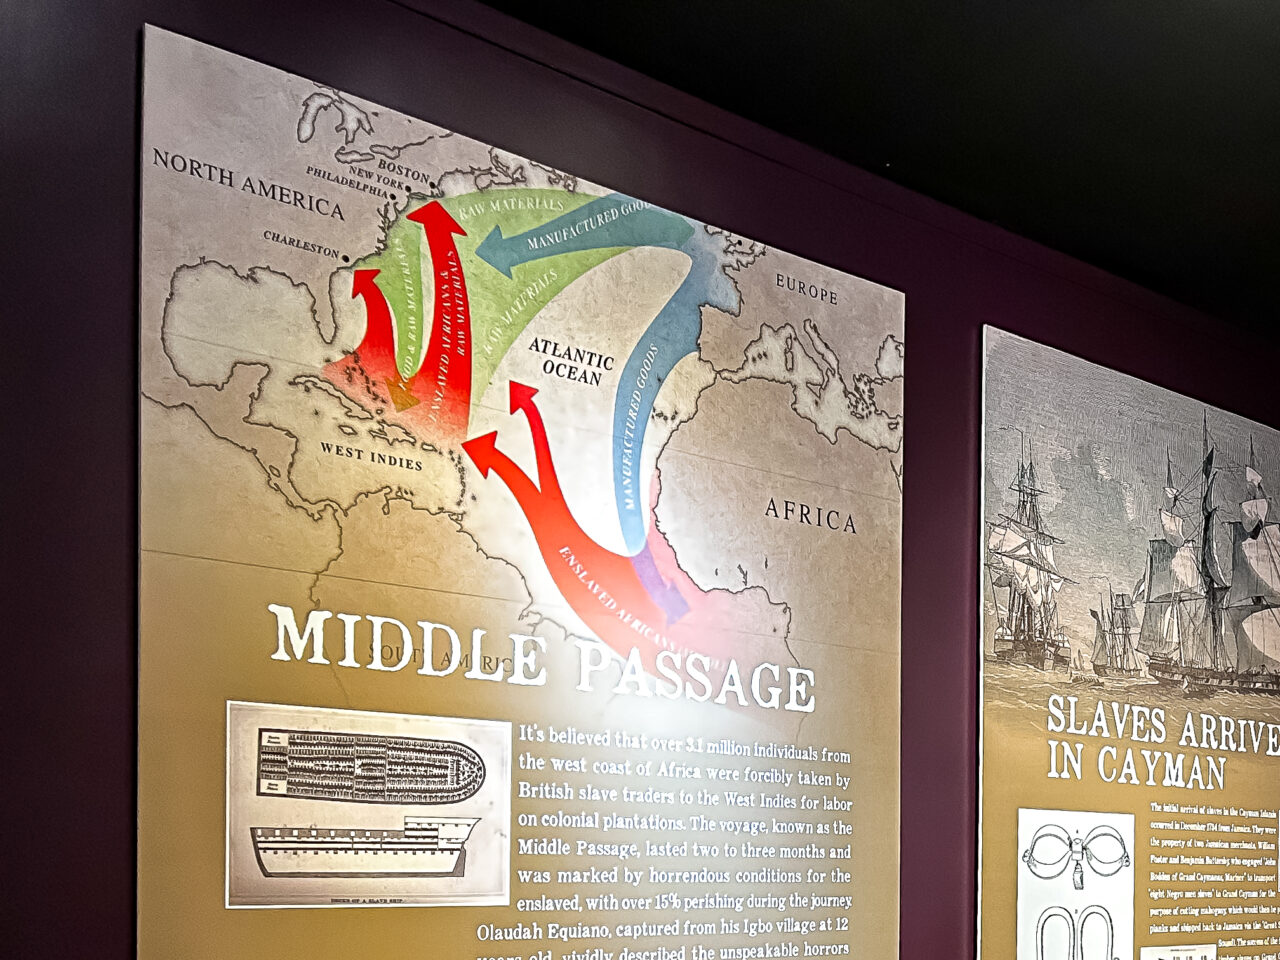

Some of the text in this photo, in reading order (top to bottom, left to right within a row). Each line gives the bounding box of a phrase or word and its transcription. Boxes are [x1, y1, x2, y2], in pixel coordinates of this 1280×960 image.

[152, 148, 346, 222] NORTH AMERICA
[306, 165, 388, 199] PHILADELPHIA
[349, 165, 404, 191] NEW YORK
[378, 159, 430, 185] BOSTON
[459, 197, 564, 221] RAW MATERIALS
[263, 229, 339, 259] CHARLESTON
[527, 208, 619, 250] MANUFACTURED
[448, 251, 465, 356] RAW MATERIALS
[775, 273, 839, 307] EUROPE
[394, 238, 417, 391] FOOD & RAW MATERIALS
[484, 268, 558, 355] RAW MATERIALS
[429, 271, 452, 422] ENSLAVED AFRICANS &
[528, 336, 615, 370] ATLANTIC
[542, 359, 602, 387] OCEAN
[621, 343, 659, 510] MANUFACTURED GOODS
[320, 441, 423, 471] WEST INDIES
[765, 497, 857, 534] AFRICA
[559, 546, 617, 610] ENSLAVED
[268, 604, 816, 713] MIDDLE PASSAGE
[1048, 694, 1166, 744] SLAVES
[1048, 740, 1226, 790] IN CAYMAN
[518, 838, 851, 860] Middle Passage, lasted two to three months and
[518, 867, 850, 886] was marked by horrendous conditions for the
[477, 918, 848, 941] Olaudah Equiano, captured from his Igbo village at 12
